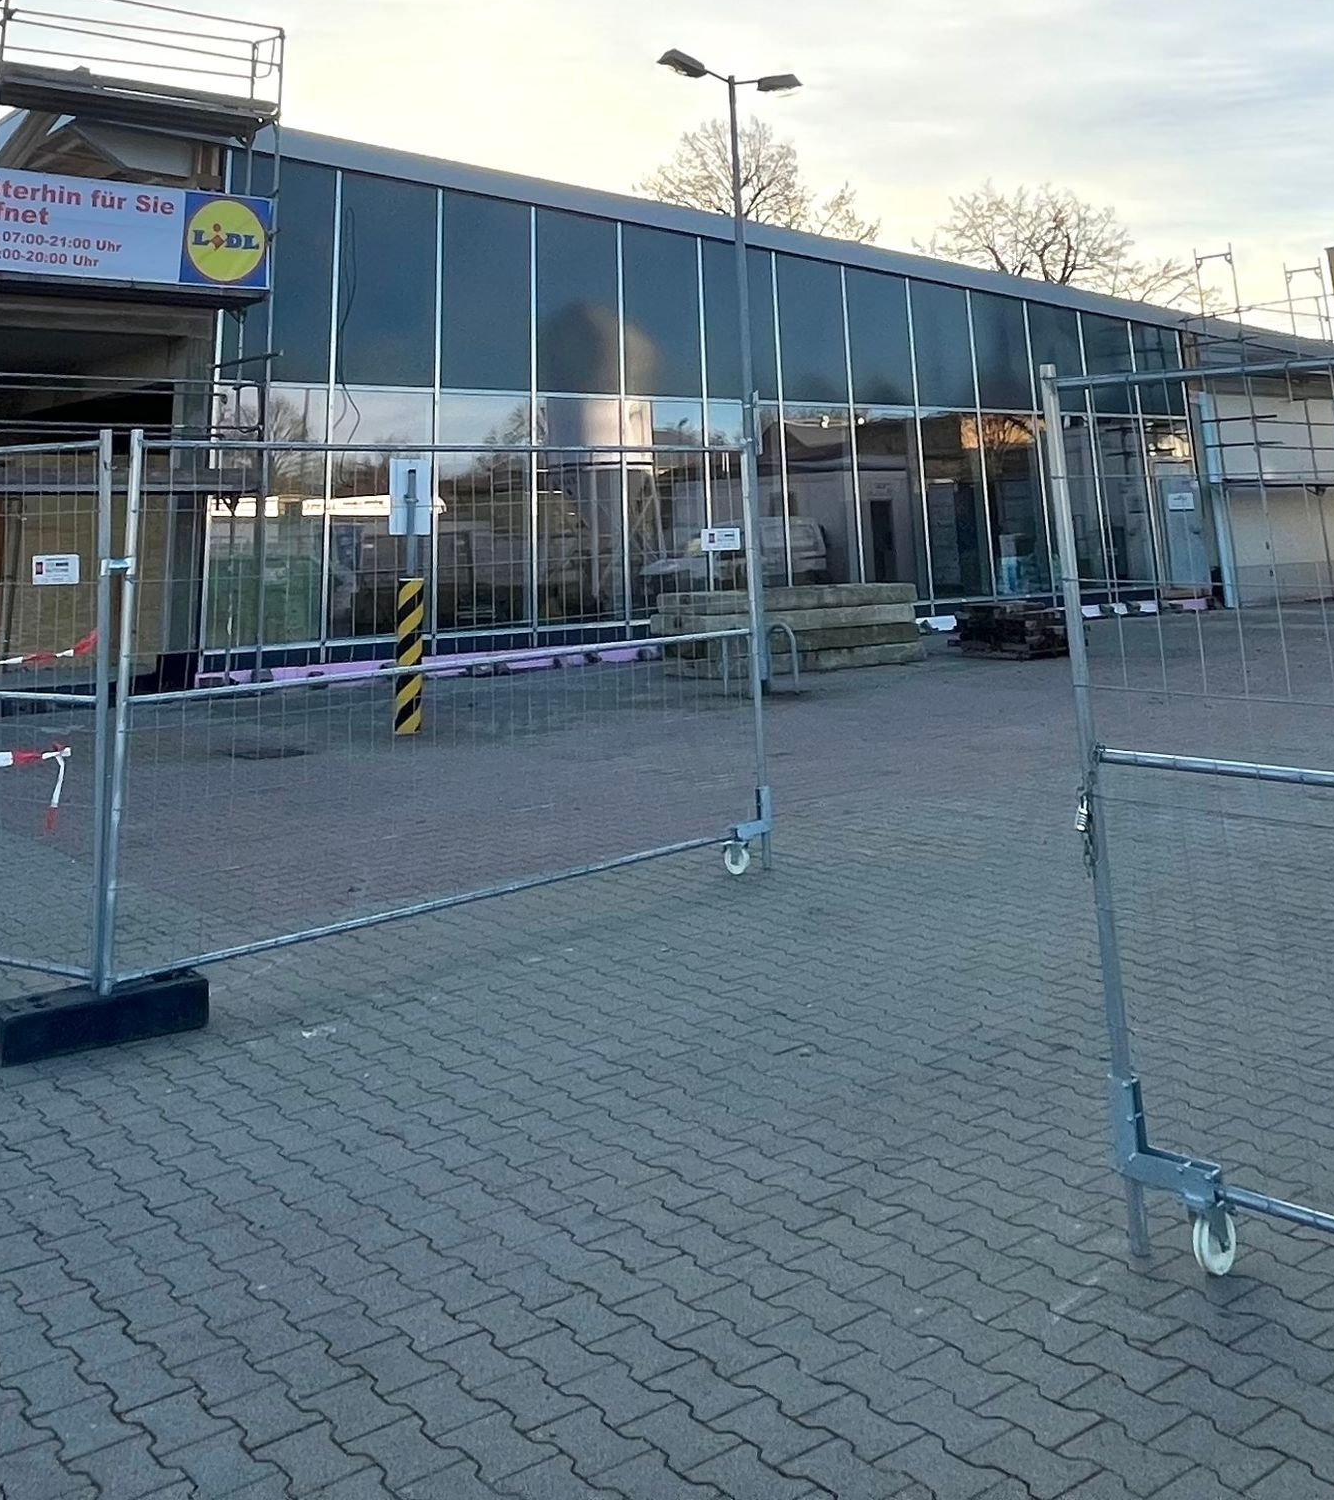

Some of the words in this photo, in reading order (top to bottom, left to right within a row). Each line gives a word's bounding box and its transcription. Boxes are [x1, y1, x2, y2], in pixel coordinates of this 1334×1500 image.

[91, 189, 127, 210] für
[135, 194, 175, 215] Sie
[2, 231, 91, 250] 07:00-21:00
[96, 240, 122, 253] Uhr
[72, 254, 99, 268] Uhr
